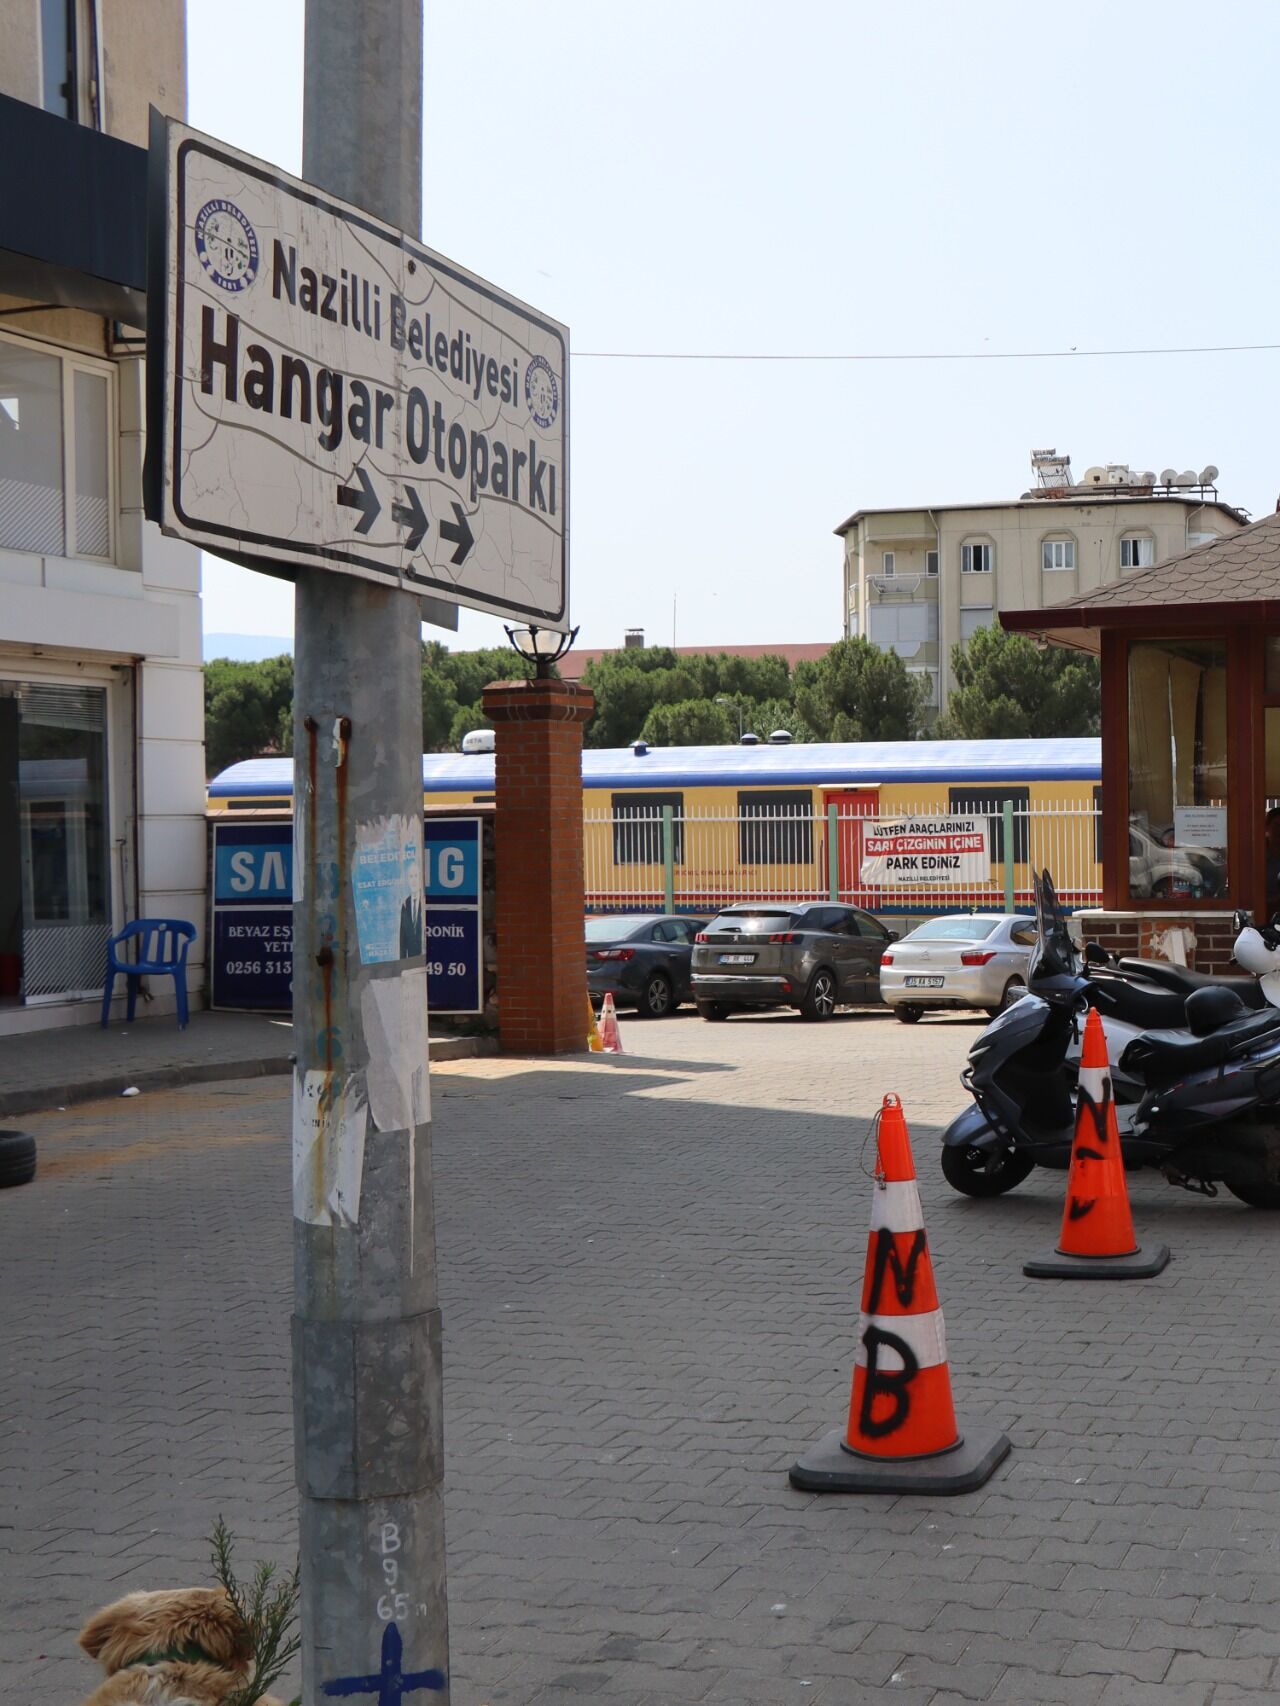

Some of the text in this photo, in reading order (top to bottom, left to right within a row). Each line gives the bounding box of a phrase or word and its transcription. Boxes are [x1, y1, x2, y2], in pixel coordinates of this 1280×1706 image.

[272, 238, 381, 341] Nazilli
[390, 293, 519, 409] Belediyesi
[200, 305, 556, 515] Hangar Otoparkı
[873, 822, 974, 836] LÜTFEN ARAÇLARINIZI
[867, 836, 981, 852] SARI ÇİZGİNİN İÇİNE
[886, 855, 960, 869] PARK EDİNİZ
[229, 926, 270, 937] BEYAZ
[226, 961, 260, 974] 0256
[265, 961, 291, 974] 313
[447, 962, 466, 976] 50
[867, 1226, 928, 1315] N
[859, 1325, 919, 1438] B
[382, 1523, 401, 1553] B
